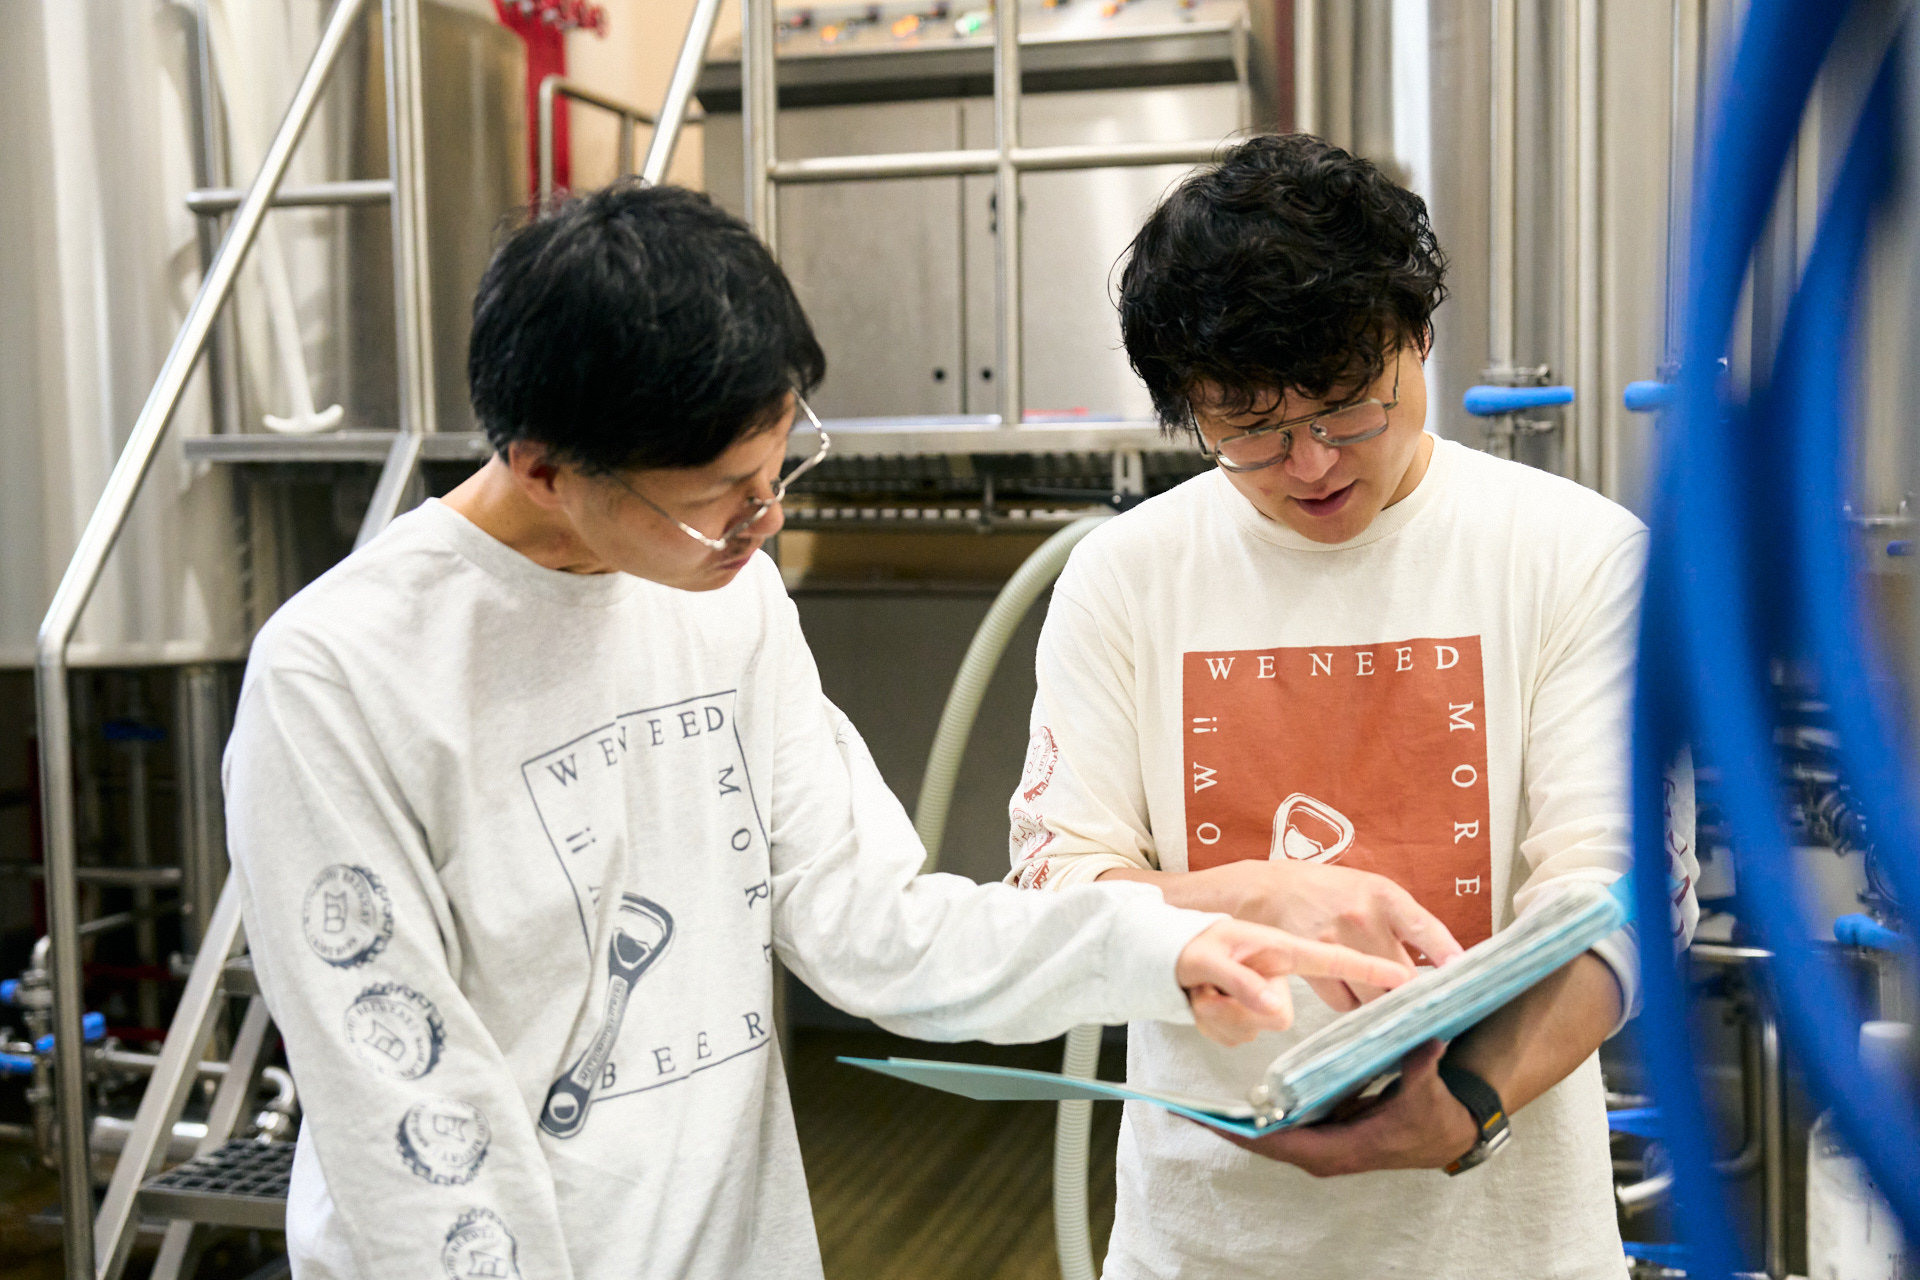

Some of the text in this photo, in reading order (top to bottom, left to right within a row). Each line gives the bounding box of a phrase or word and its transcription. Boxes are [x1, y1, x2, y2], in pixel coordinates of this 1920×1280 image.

[1205, 645, 1459, 680] WE NEED
[546, 737, 617, 787] WE
[1193, 717, 1221, 845] OW!!
[1449, 701, 1480, 897] MORE
[600, 1011, 765, 1090] BEER
